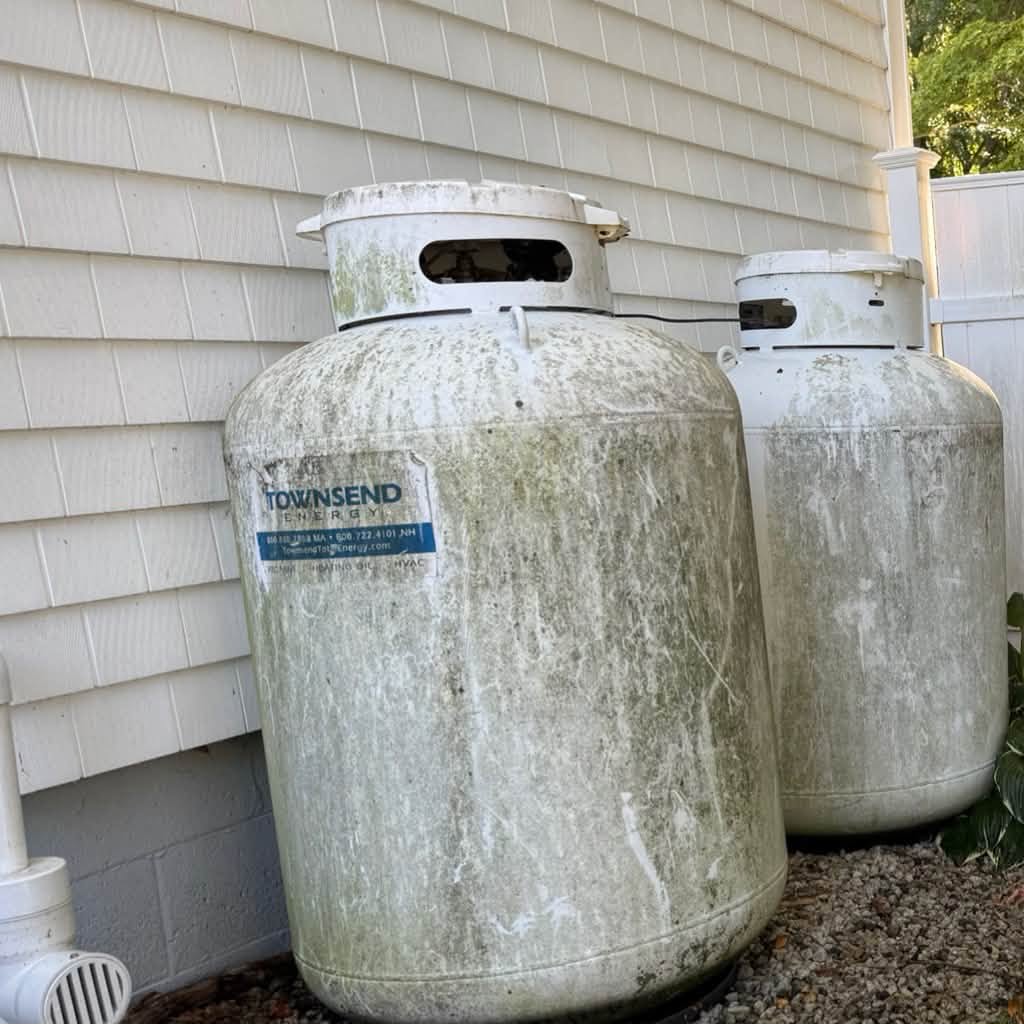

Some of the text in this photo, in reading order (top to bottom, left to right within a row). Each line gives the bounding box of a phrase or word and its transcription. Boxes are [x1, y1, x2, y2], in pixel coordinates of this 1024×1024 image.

[265, 483, 402, 511] TOWNSEND
[284, 508, 378, 522] ENERGY
[399, 528, 416, 538] NH
[394, 558, 425, 568] HVAC
